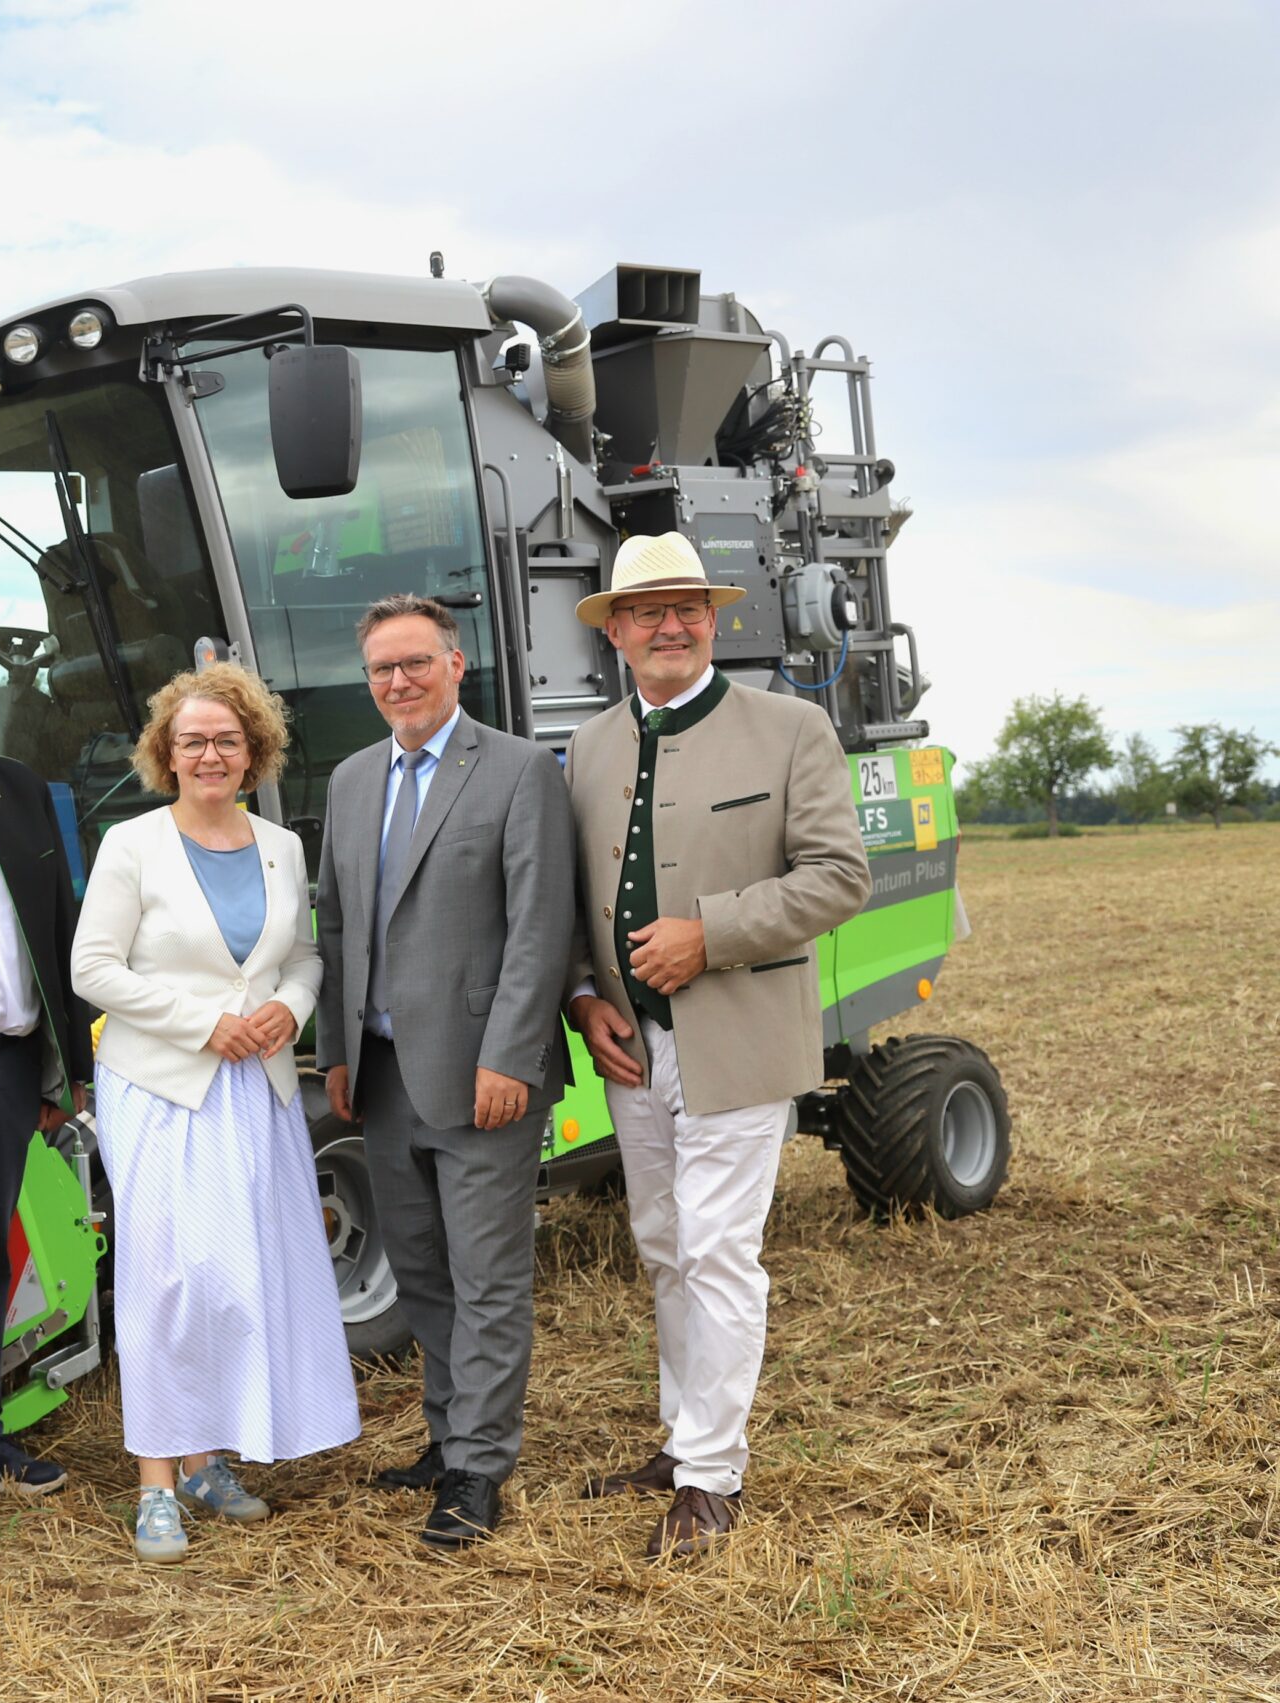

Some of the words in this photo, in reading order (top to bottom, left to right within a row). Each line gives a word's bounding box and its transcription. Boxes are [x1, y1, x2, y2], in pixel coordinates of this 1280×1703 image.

[701, 540, 754, 549] WINTERSTEIGER
[861, 761, 881, 796] 25
[883, 777, 895, 794] km
[875, 871, 911, 894] ntum
[916, 861, 946, 884] Plus
